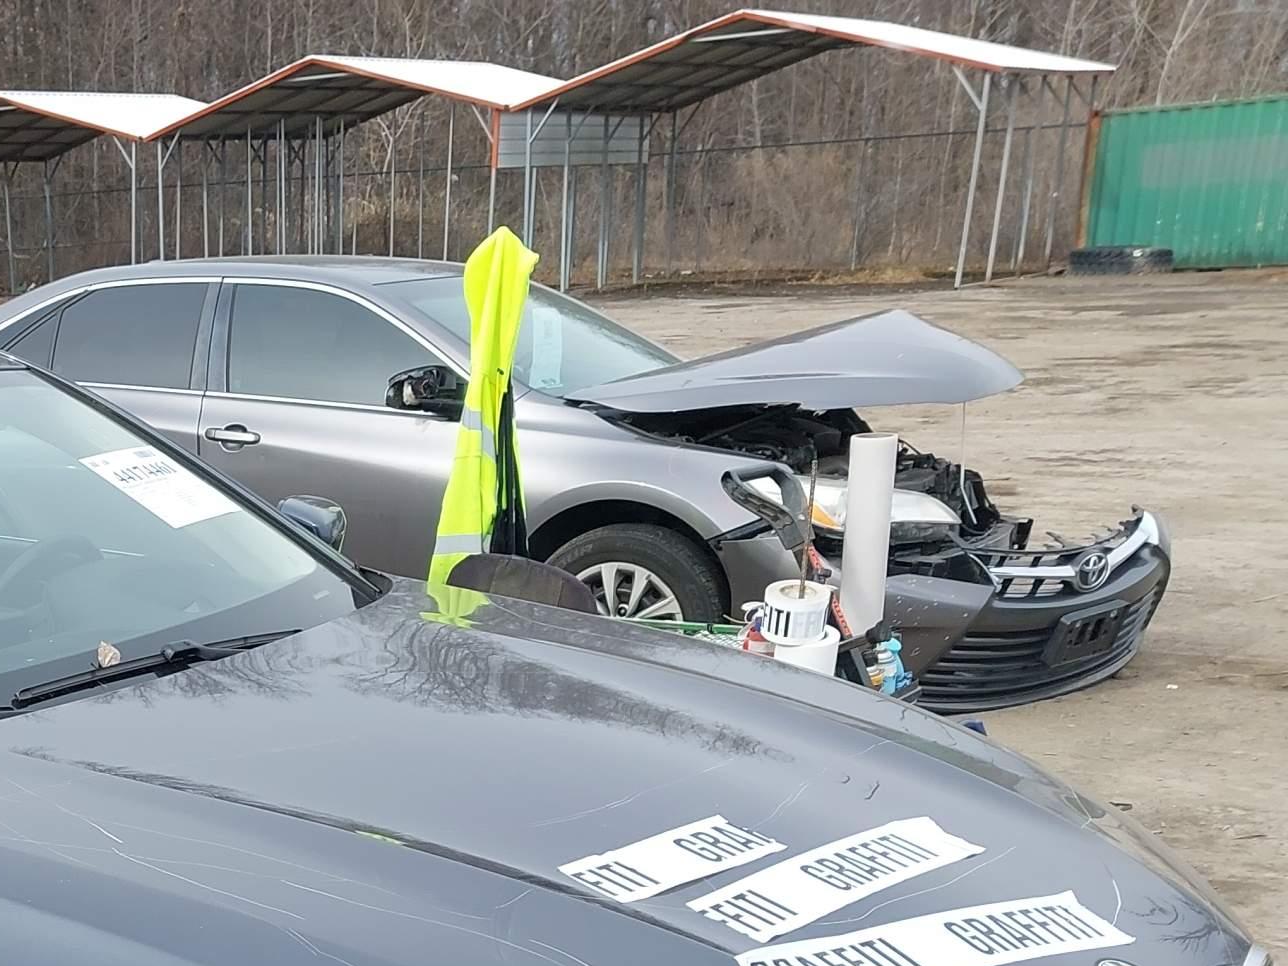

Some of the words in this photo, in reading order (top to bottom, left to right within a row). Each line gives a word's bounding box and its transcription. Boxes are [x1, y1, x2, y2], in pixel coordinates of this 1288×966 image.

[113, 461, 177, 484] 44174461
[570, 861, 662, 896] FITI
[698, 890, 799, 932] FITI
[800, 833, 940, 891] GRAFFITI
[943, 905, 1105, 955] GRAFFITI
